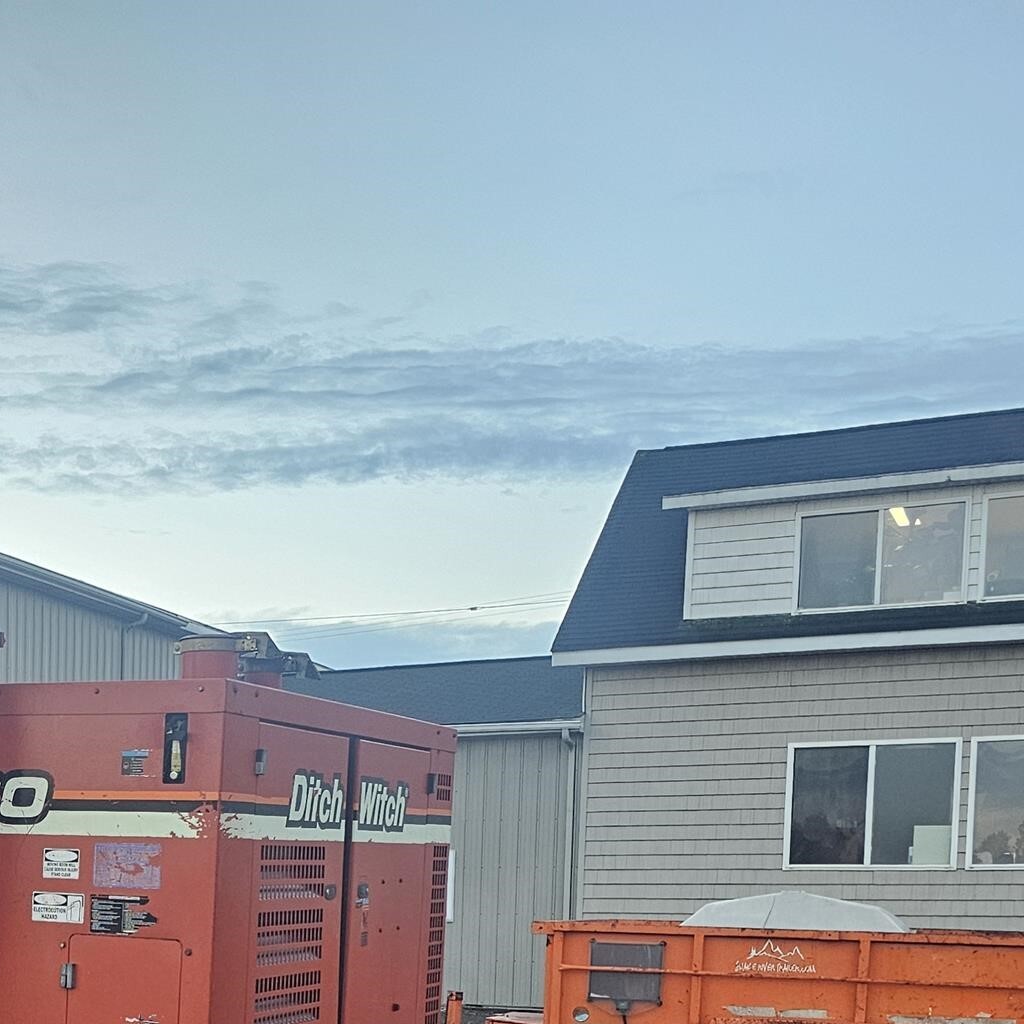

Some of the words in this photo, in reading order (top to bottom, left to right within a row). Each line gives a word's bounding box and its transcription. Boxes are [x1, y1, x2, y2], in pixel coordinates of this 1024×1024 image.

[288, 774, 343, 824] Ditch
[359, 781, 406, 826] Witch
[33, 906, 67, 914] ELECTROCUTION
